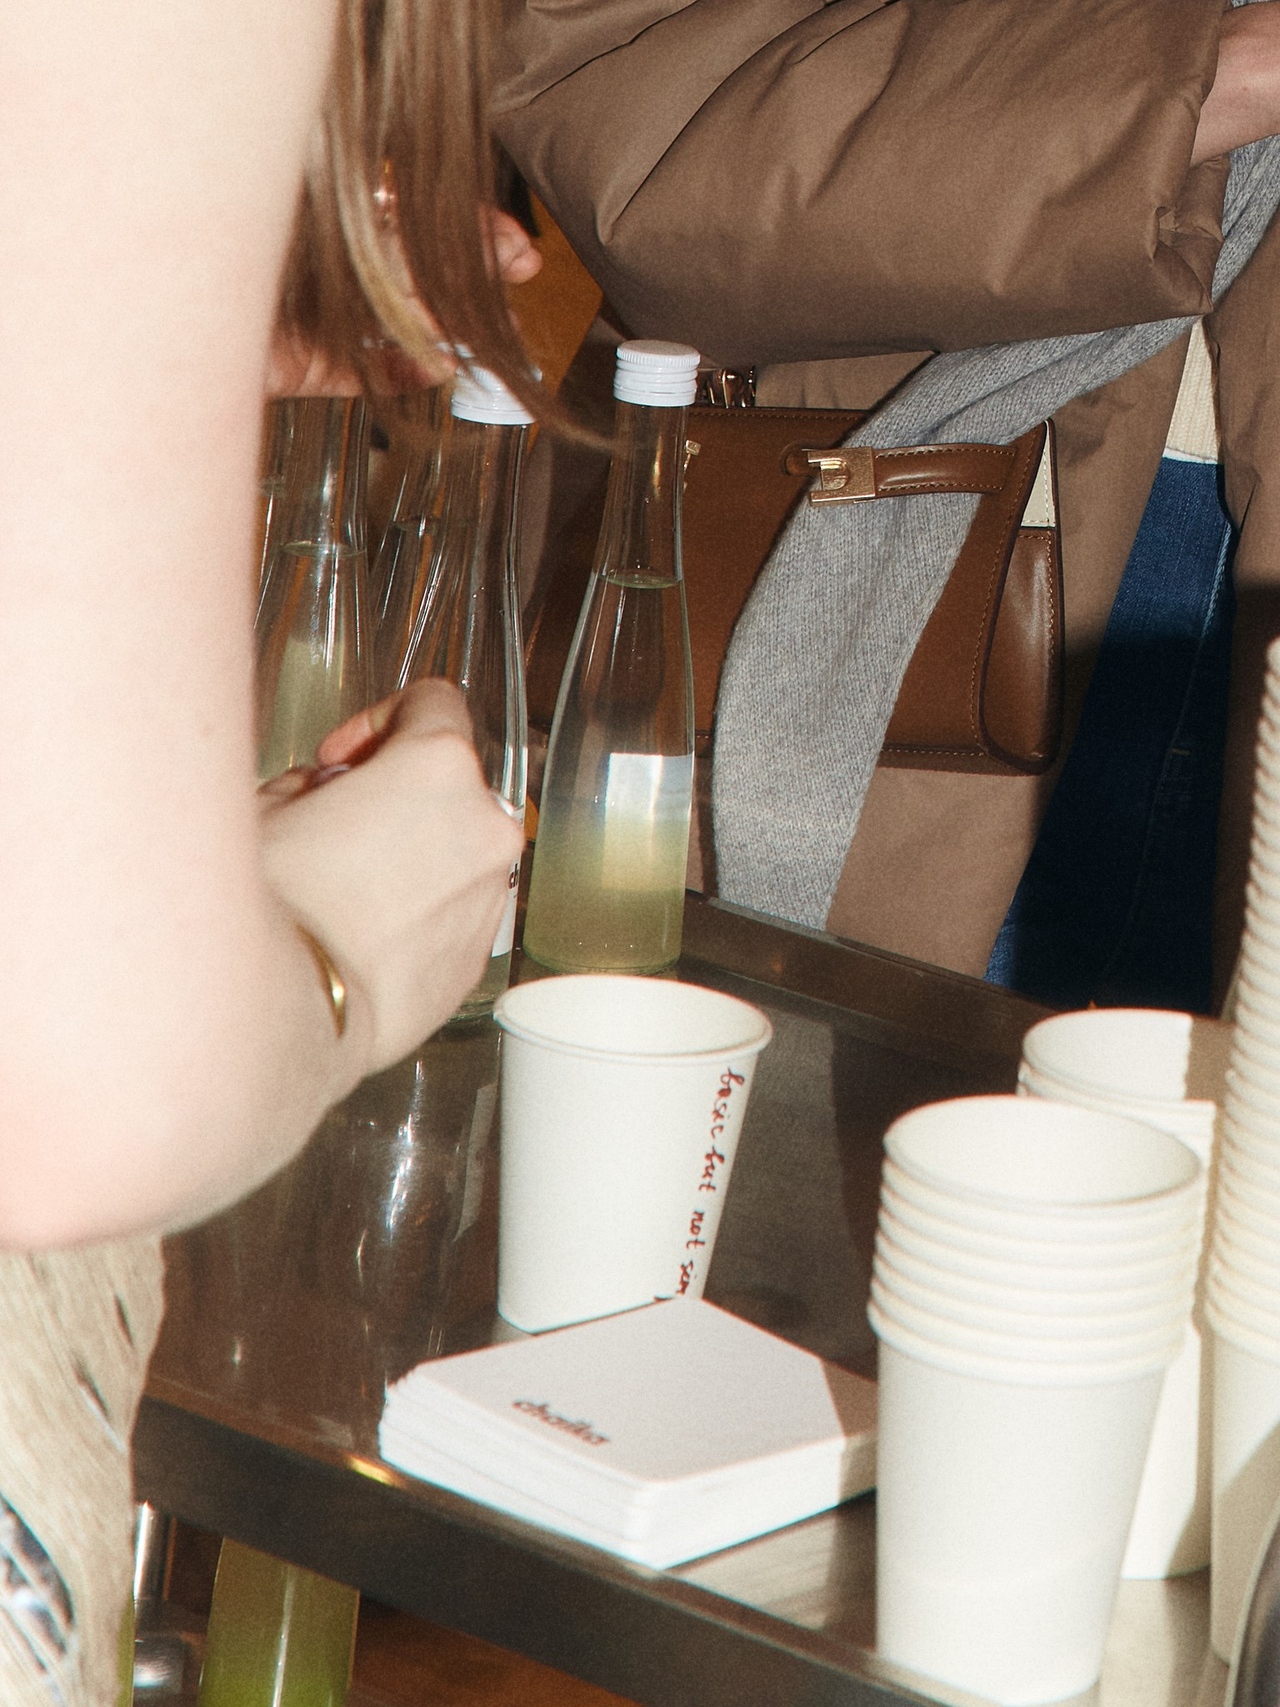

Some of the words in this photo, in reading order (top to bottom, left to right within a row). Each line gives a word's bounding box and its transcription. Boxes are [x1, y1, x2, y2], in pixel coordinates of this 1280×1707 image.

[710, 1067, 745, 1140] basic
[698, 1146, 725, 1192] but
[685, 1210, 706, 1249] not
